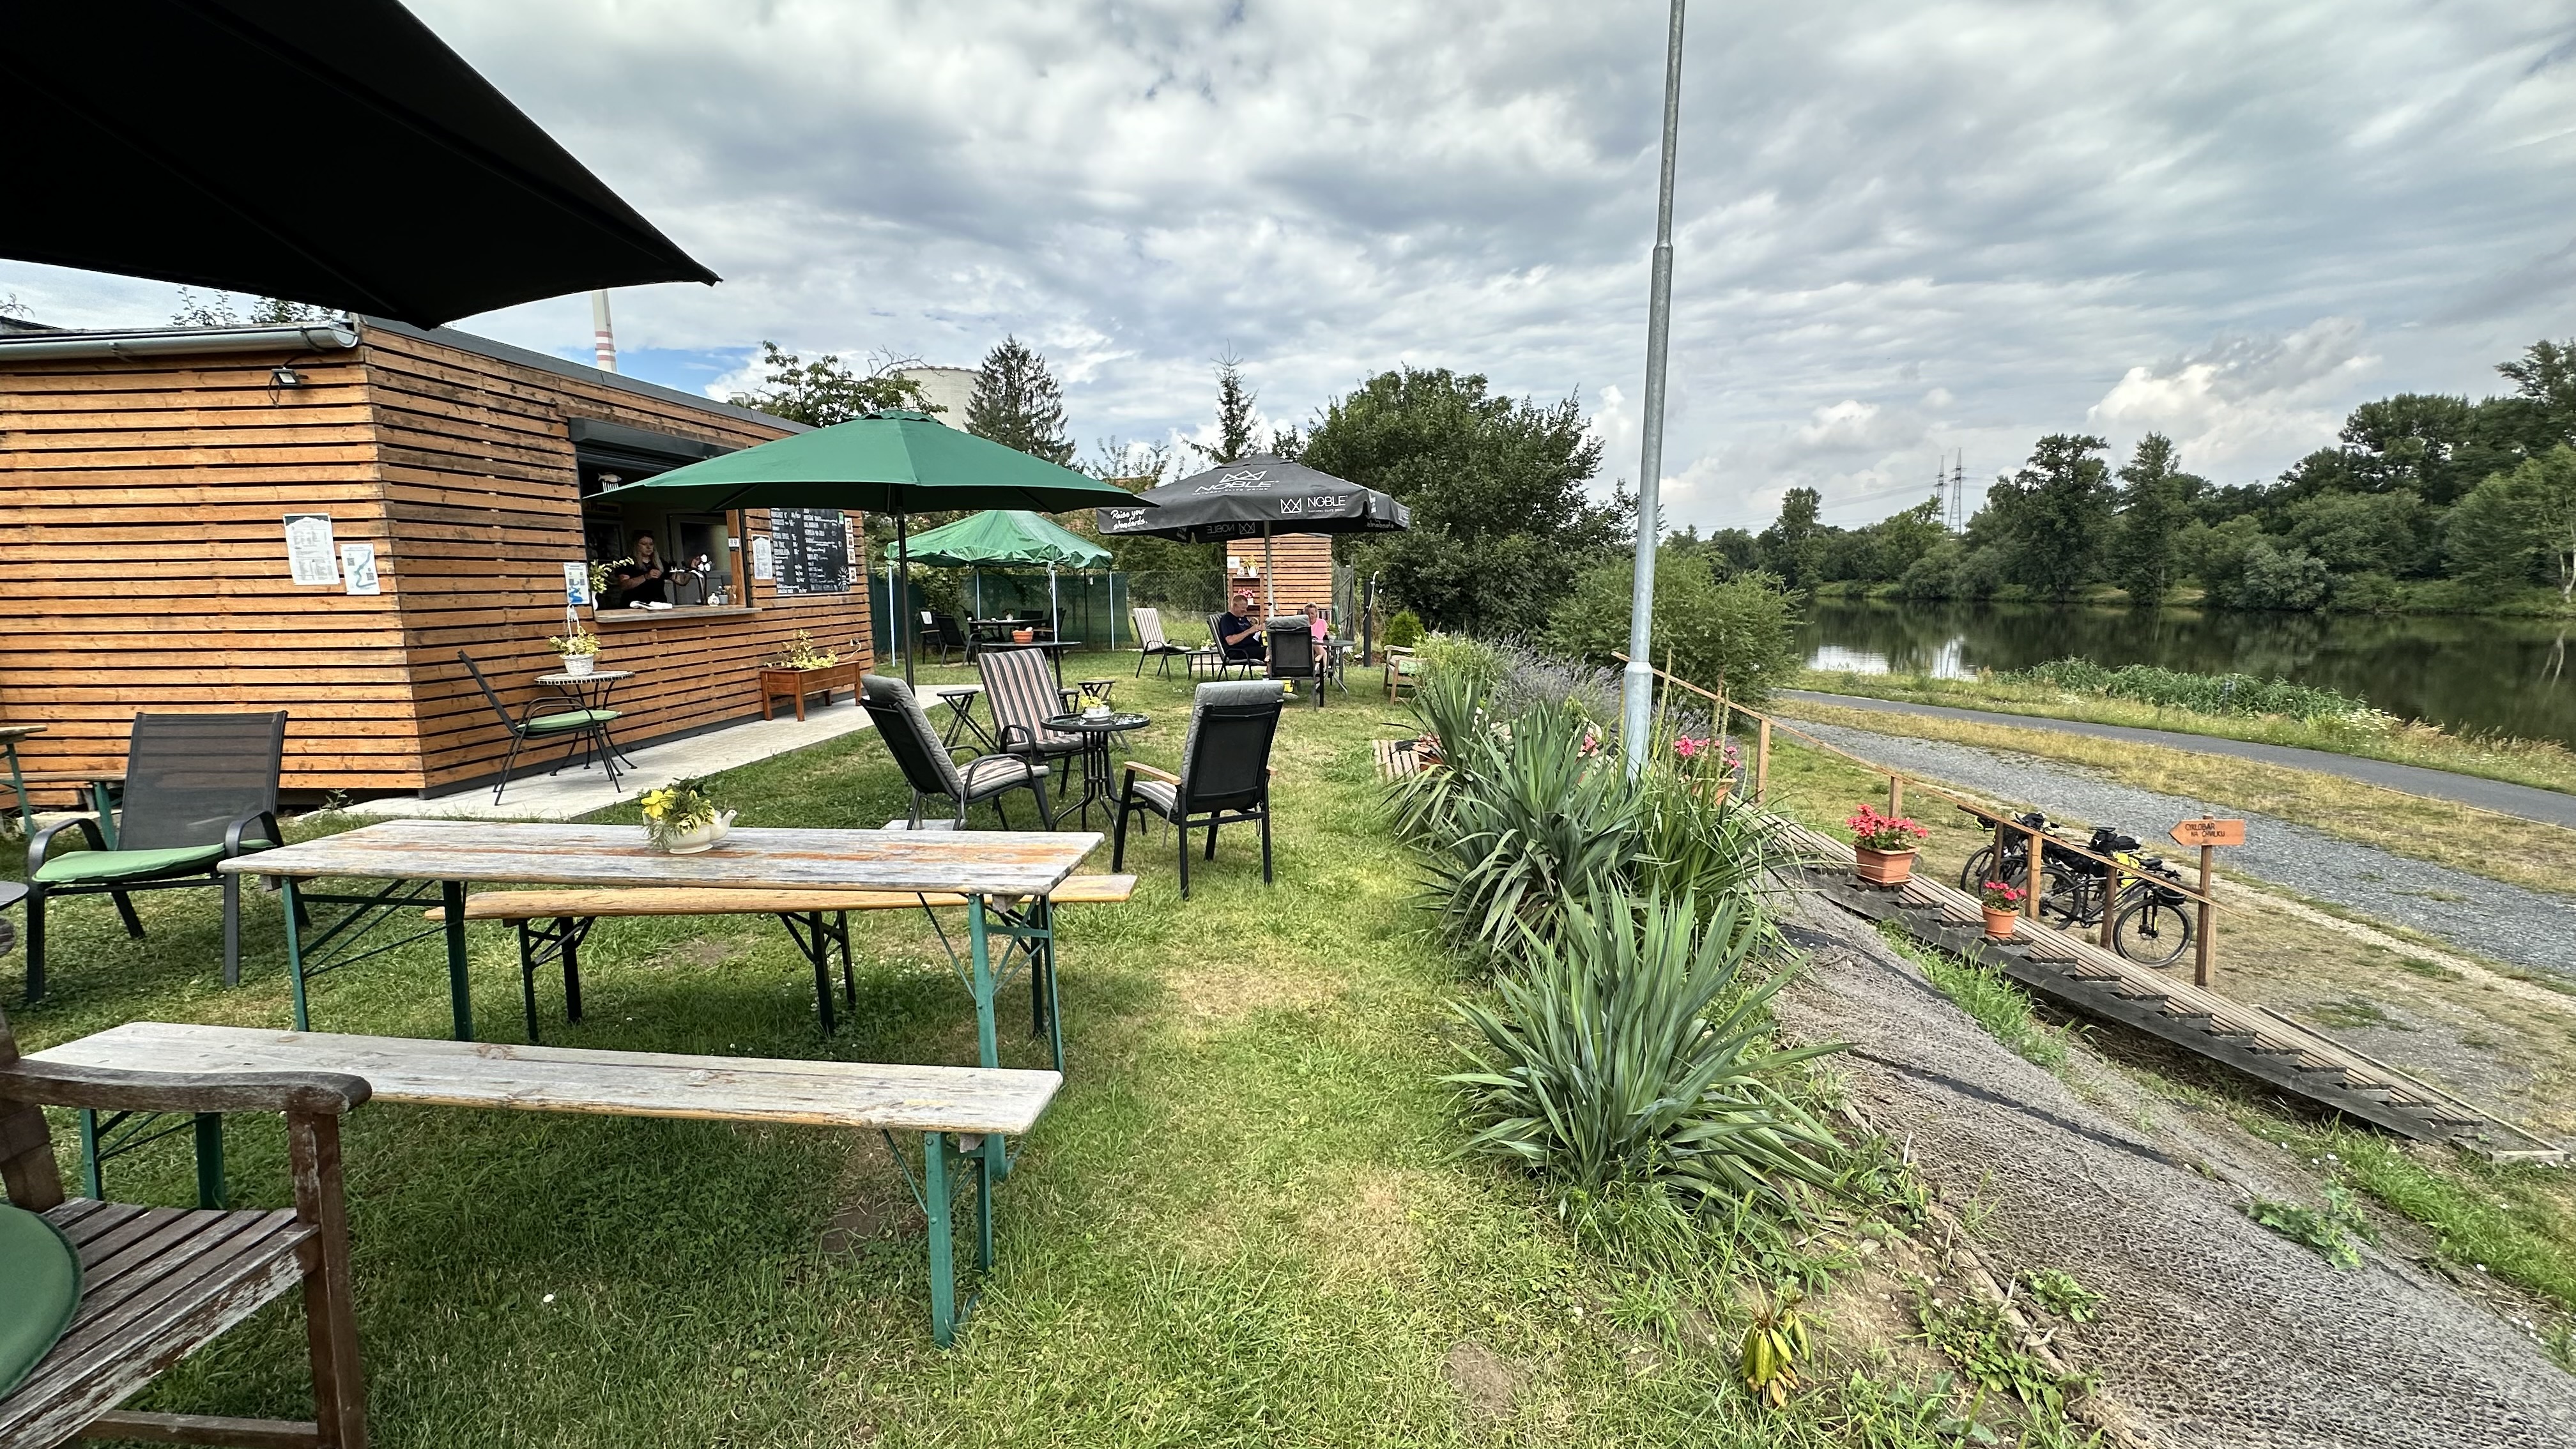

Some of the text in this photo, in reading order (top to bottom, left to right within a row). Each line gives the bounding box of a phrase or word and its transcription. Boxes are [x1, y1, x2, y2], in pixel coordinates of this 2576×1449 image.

[1195, 480, 1275, 493] NOBLE
[1307, 495, 1346, 507] NOBLE
[1110, 509, 1146, 519] Raise your
[1113, 516, 1148, 530] standards.
[2185, 822, 2215, 831] CYKLOBAR
